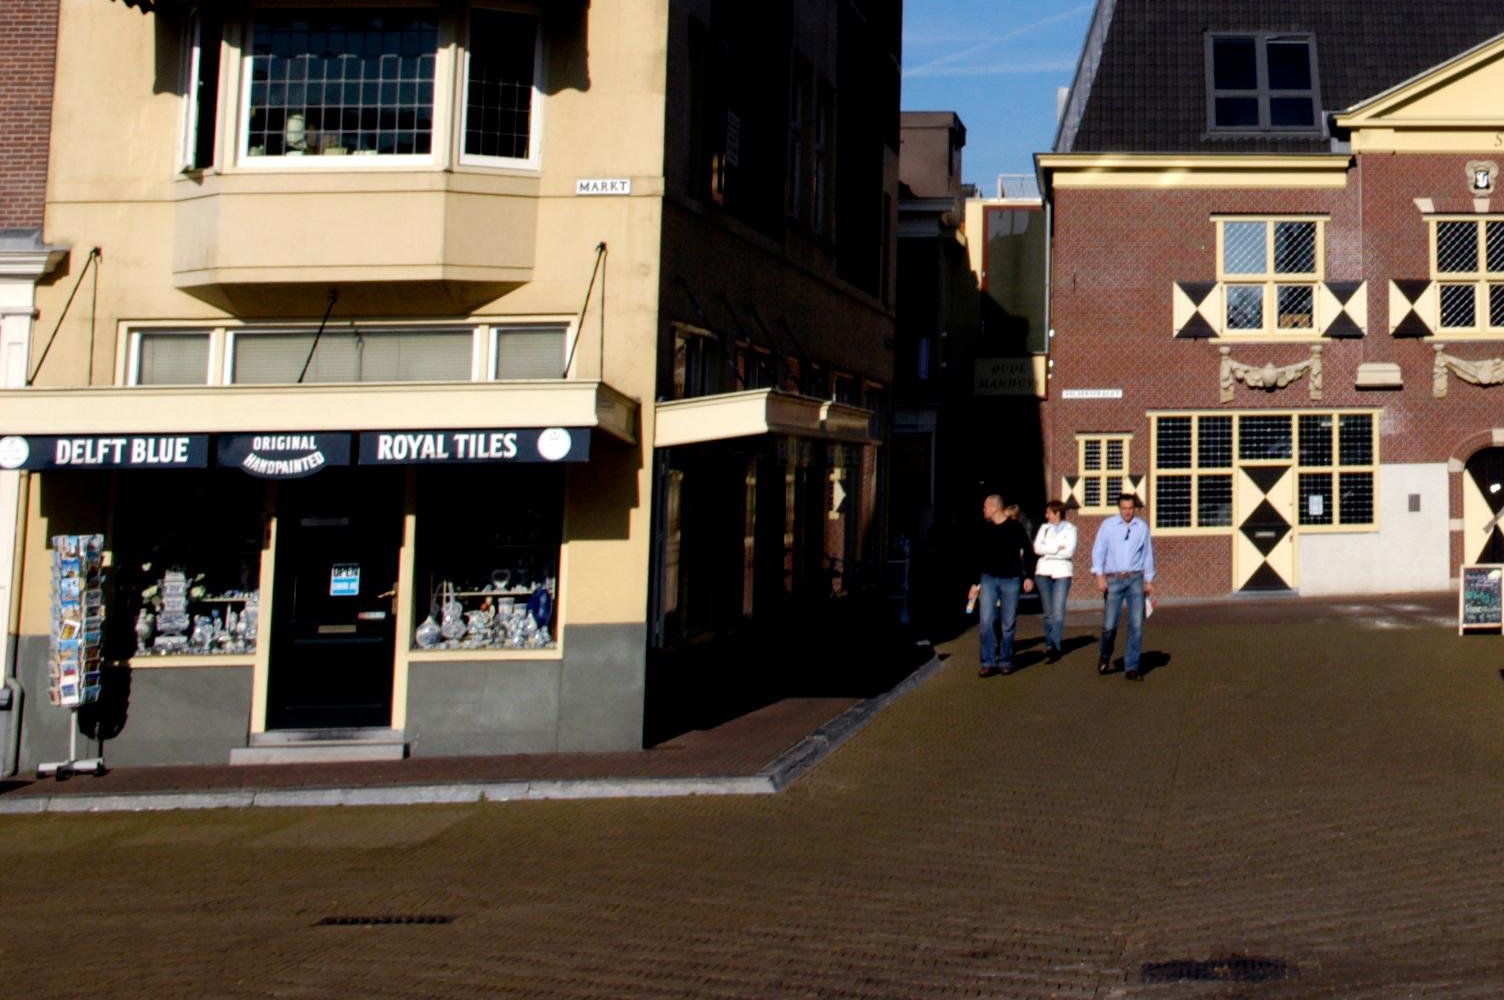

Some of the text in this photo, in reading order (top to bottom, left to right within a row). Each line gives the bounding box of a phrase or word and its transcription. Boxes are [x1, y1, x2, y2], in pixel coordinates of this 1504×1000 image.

[579, 181, 628, 192] MARKT
[54, 437, 189, 465] DELFT BLUE
[252, 436, 317, 451] ORIGINAL
[377, 432, 517, 460] ROYAL TILES
[242, 450, 325, 476] HANDPAINTED
